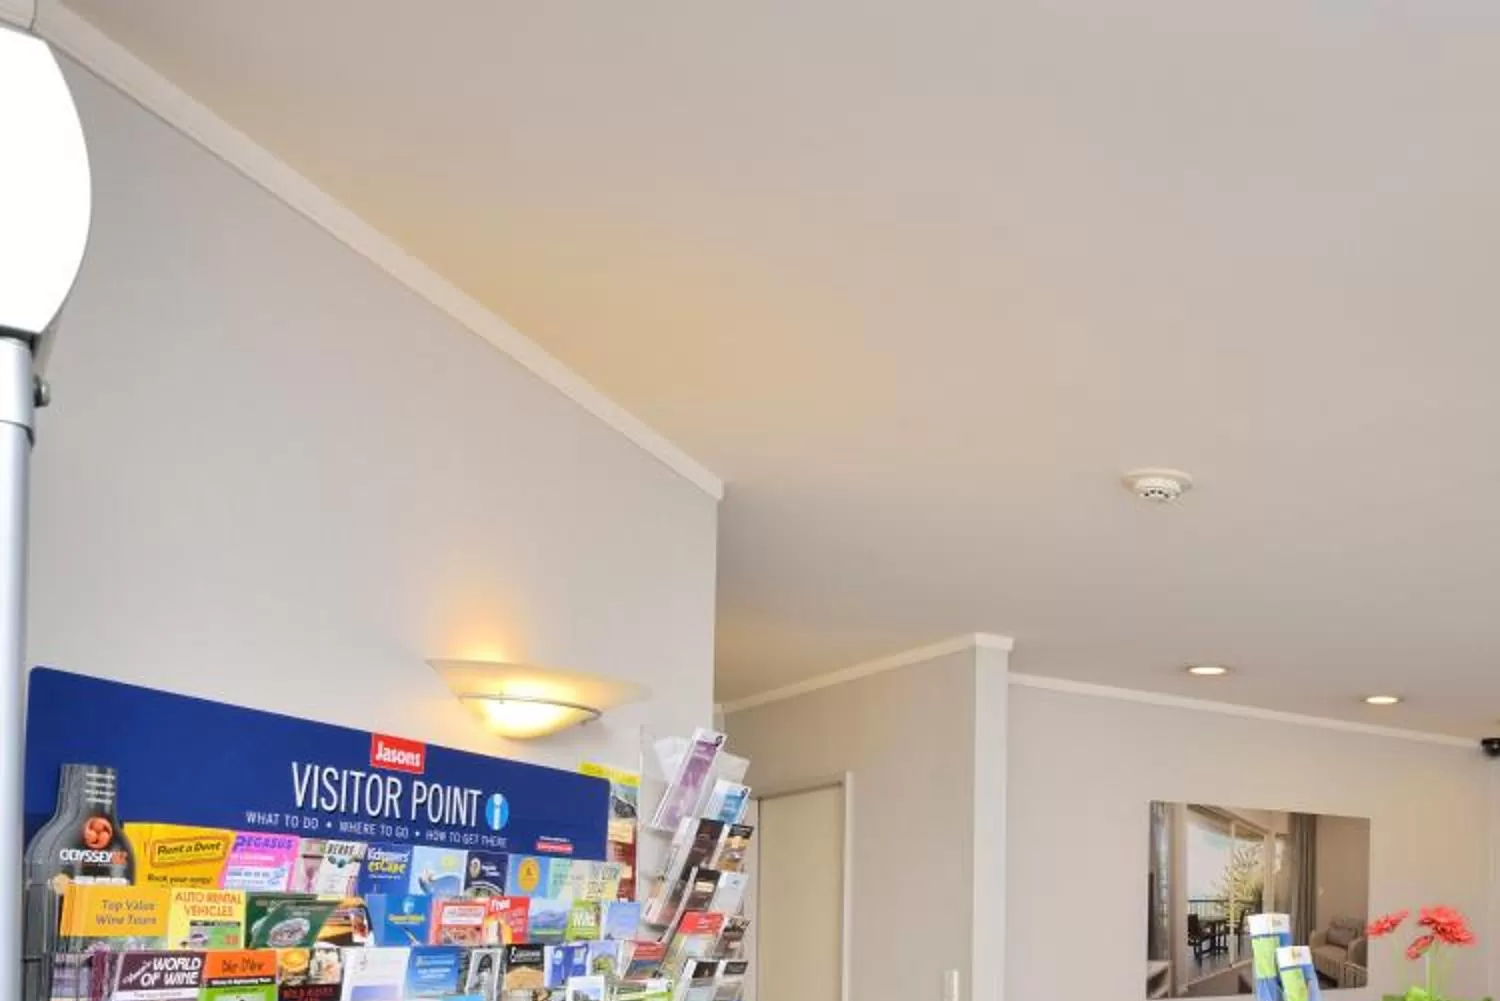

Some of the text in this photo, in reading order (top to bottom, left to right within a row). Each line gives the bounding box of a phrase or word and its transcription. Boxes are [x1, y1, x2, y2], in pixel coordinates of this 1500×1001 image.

[376, 741, 420, 767] Jasons
[292, 761, 402, 819] VISITOR
[411, 781, 481, 827] POINT
[246, 811, 507, 849] WHAT TO DO WHERE TO GO HOW TO GET THERE
[157, 845, 184, 855] Rent
[175, 891, 242, 903] AUTO RENTAL
[102, 899, 155, 912] Top Value
[184, 905, 234, 917] VEHICLES
[95, 914, 156, 925] Wine Tours
[152, 957, 201, 970] WORLD
[140, 972, 161, 987] OF
[164, 971, 199, 985] WINE
